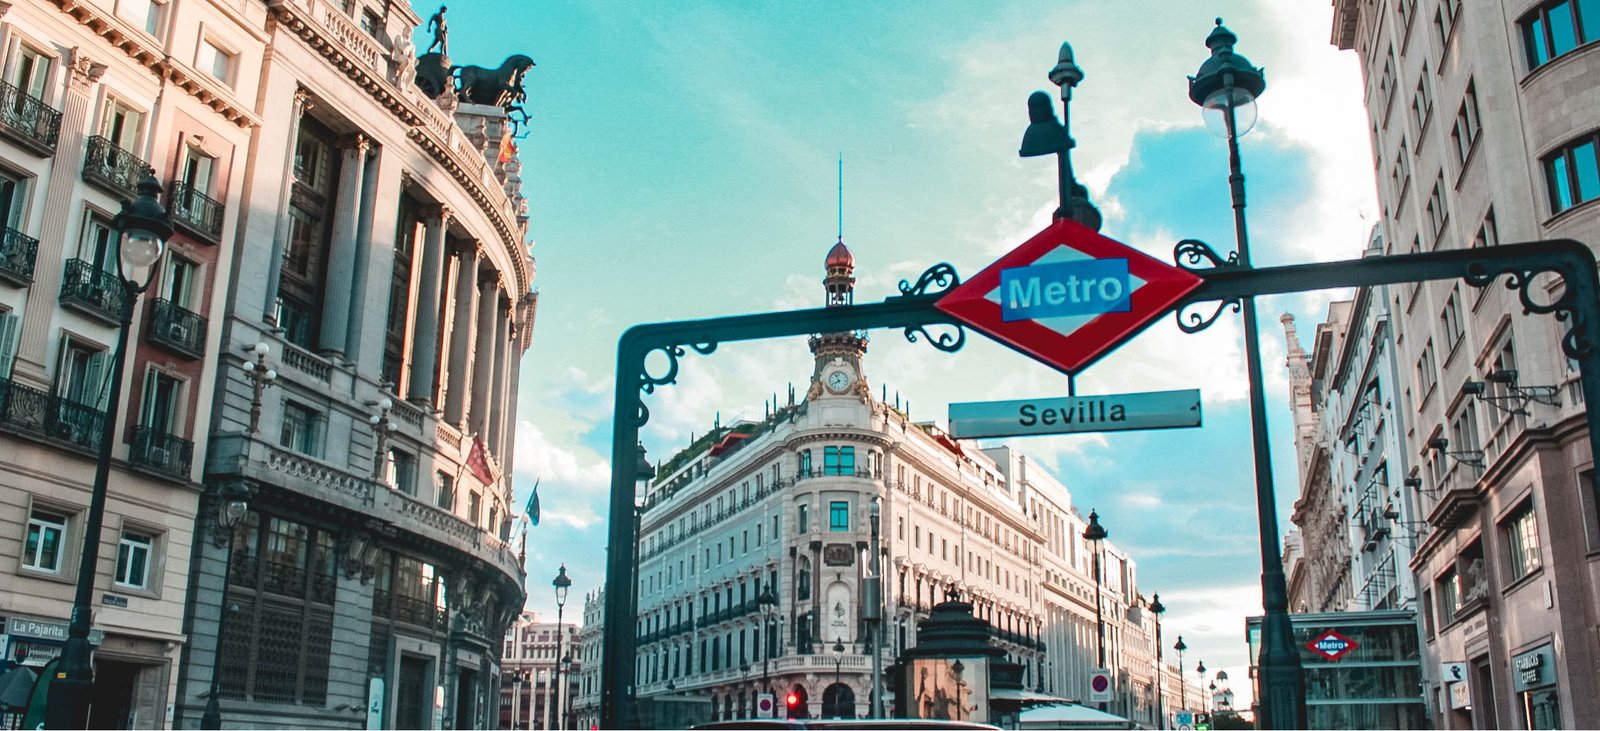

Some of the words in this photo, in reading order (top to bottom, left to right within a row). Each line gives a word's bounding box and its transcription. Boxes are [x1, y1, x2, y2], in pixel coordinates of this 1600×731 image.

[1008, 276, 1123, 310] Metro
[1018, 400, 1127, 426] Sevilla
[13, 620, 26, 632] La
[28, 622, 64, 637] Pajarita
[1319, 641, 1344, 650] Metro
